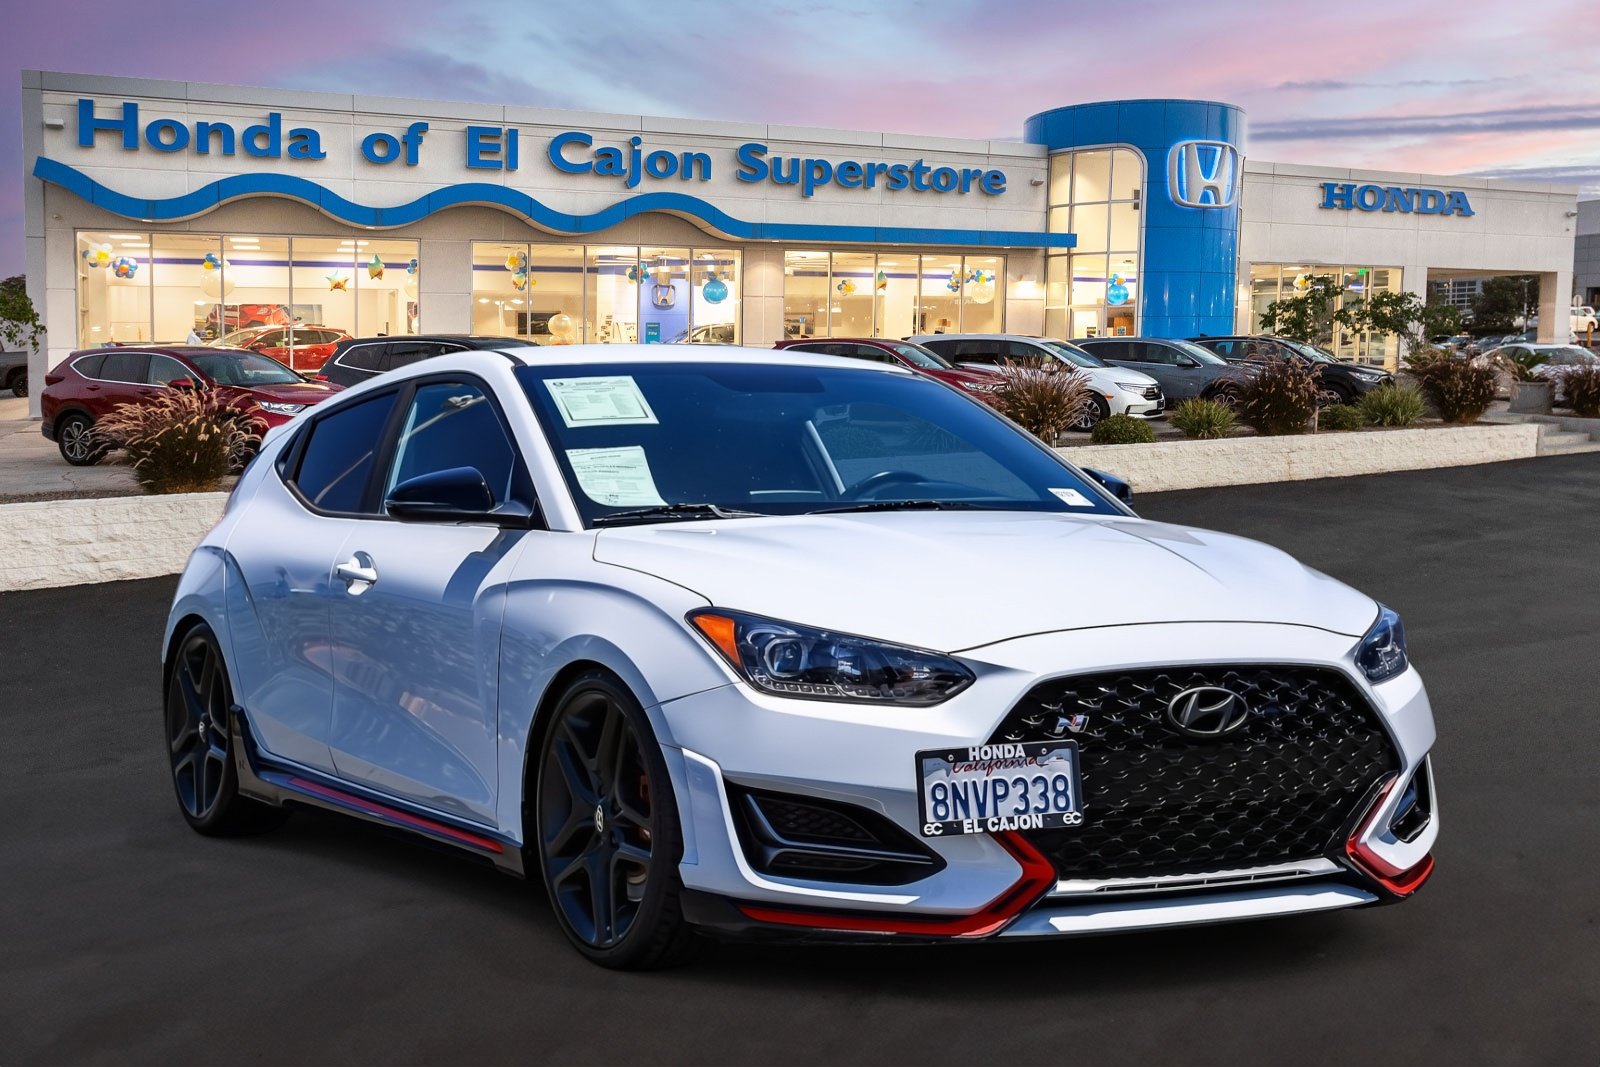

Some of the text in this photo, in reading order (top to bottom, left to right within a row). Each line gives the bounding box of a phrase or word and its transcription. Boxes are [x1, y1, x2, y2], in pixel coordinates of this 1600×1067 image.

[78, 98, 1007, 197] Honda of El Cajon Superstore
[1319, 182, 1475, 217] HONDA
[968, 743, 1026, 761] HONDA
[931, 773, 1070, 821] 8NVP338
[963, 813, 1043, 834] EL CAJON
